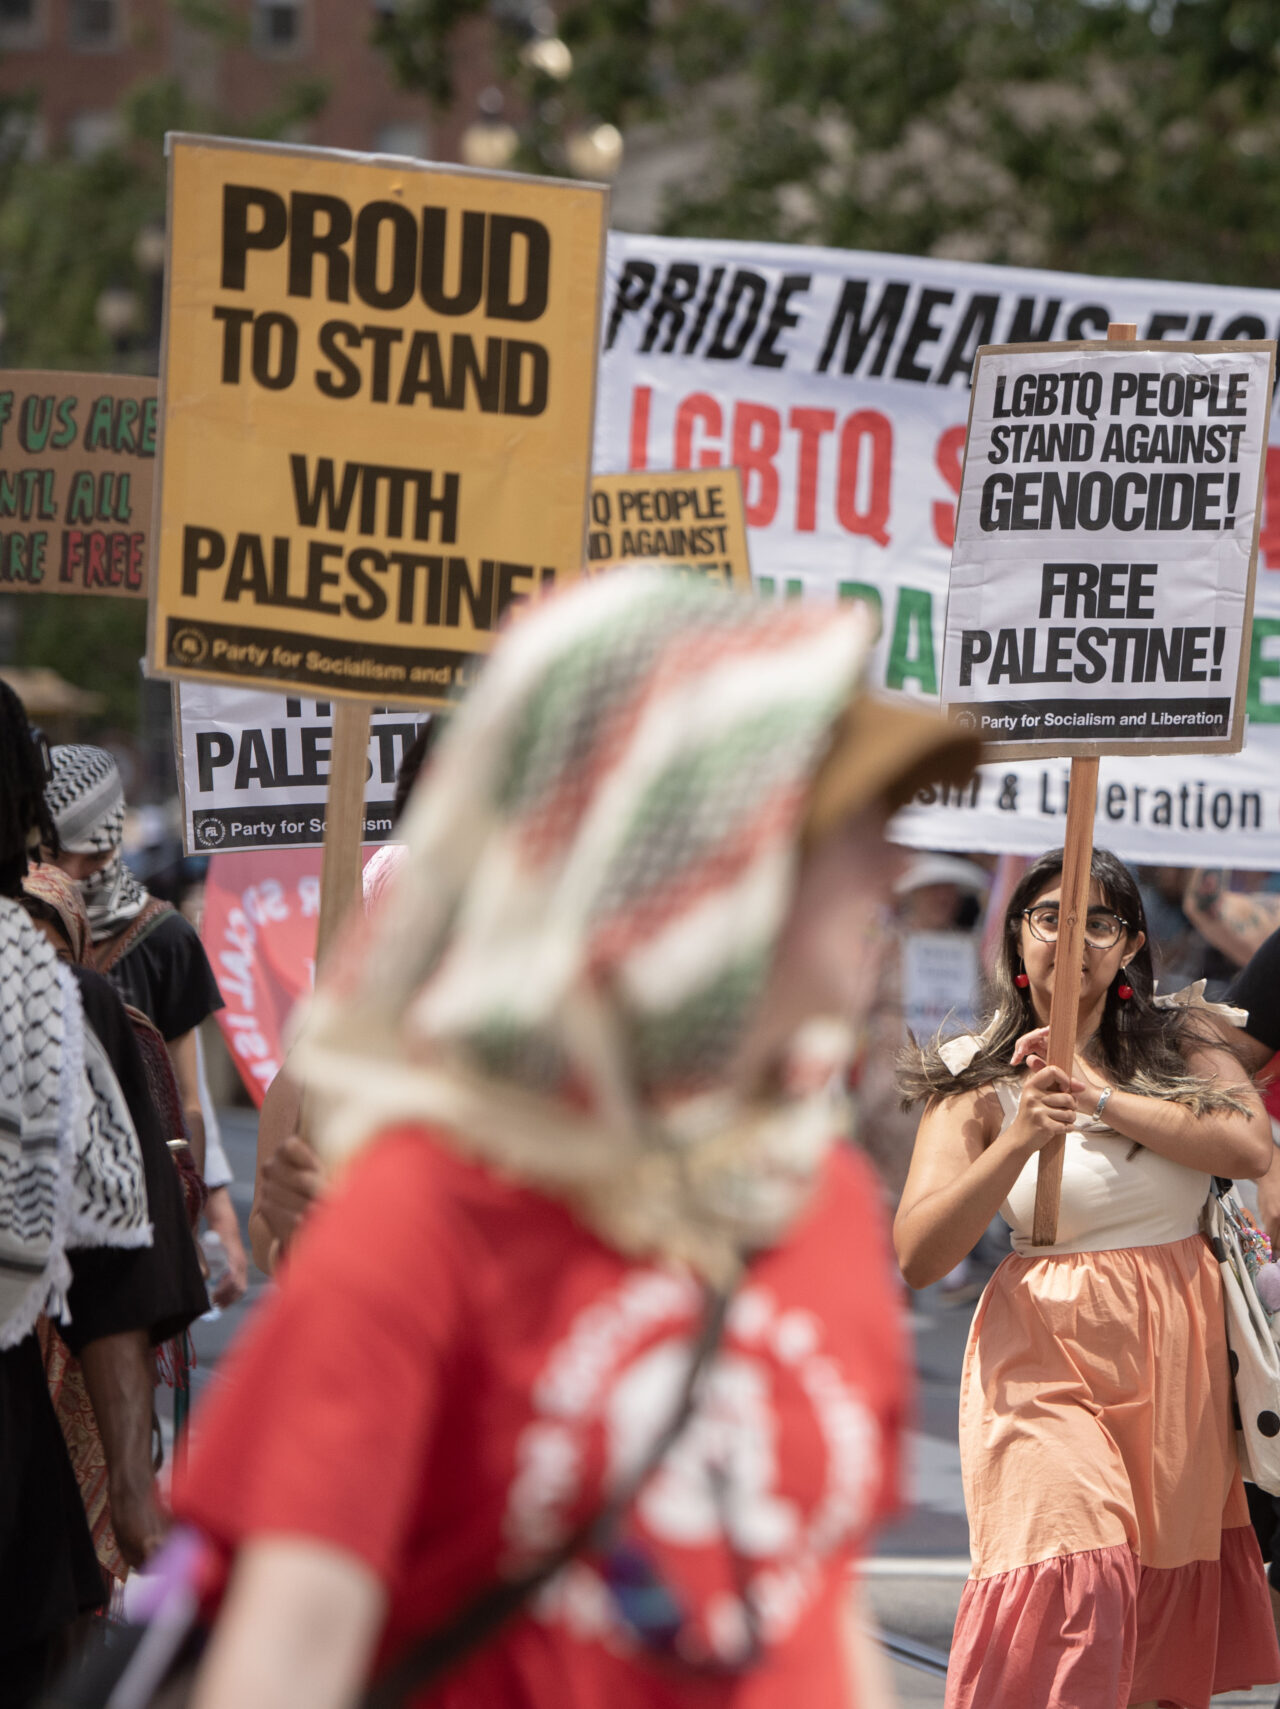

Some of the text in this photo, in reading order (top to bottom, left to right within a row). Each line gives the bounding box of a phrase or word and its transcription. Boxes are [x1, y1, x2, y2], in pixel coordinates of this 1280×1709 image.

[221, 183, 550, 322] PROUD
[603, 259, 810, 369] PRIDE
[213, 305, 550, 417] TO STAND
[993, 371, 1250, 421] LGBTQ PEOPLE
[18, 393, 79, 455] US
[83, 394, 158, 459] ARE
[987, 422, 1246, 465] STAND AGAINST
[65, 470, 132, 525] ALL
[290, 453, 460, 544] WITH
[616, 486, 726, 525] PEOPLE
[979, 471, 1241, 533] GENOCIDE!
[59, 529, 145, 591] FREE
[621, 525, 728, 558] AGAINST
[1038, 562, 1159, 620] FREE
[212, 638, 267, 668] Party
[272, 646, 301, 668] for
[305, 650, 404, 682] Socialism
[409, 661, 450, 683] and
[958, 626, 1226, 688] PALESTINE!
[981, 714, 1017, 731] Party
[1021, 713, 1041, 727] for
[1043, 712, 1116, 727] Socialism
[1119, 711, 1147, 726] and
[1151, 711, 1224, 726] Liberation
[230, 821, 276, 838] Party
[280, 819, 305, 834] for
[309, 817, 392, 832] Soism
[1041, 771, 1261, 831] Lieration
